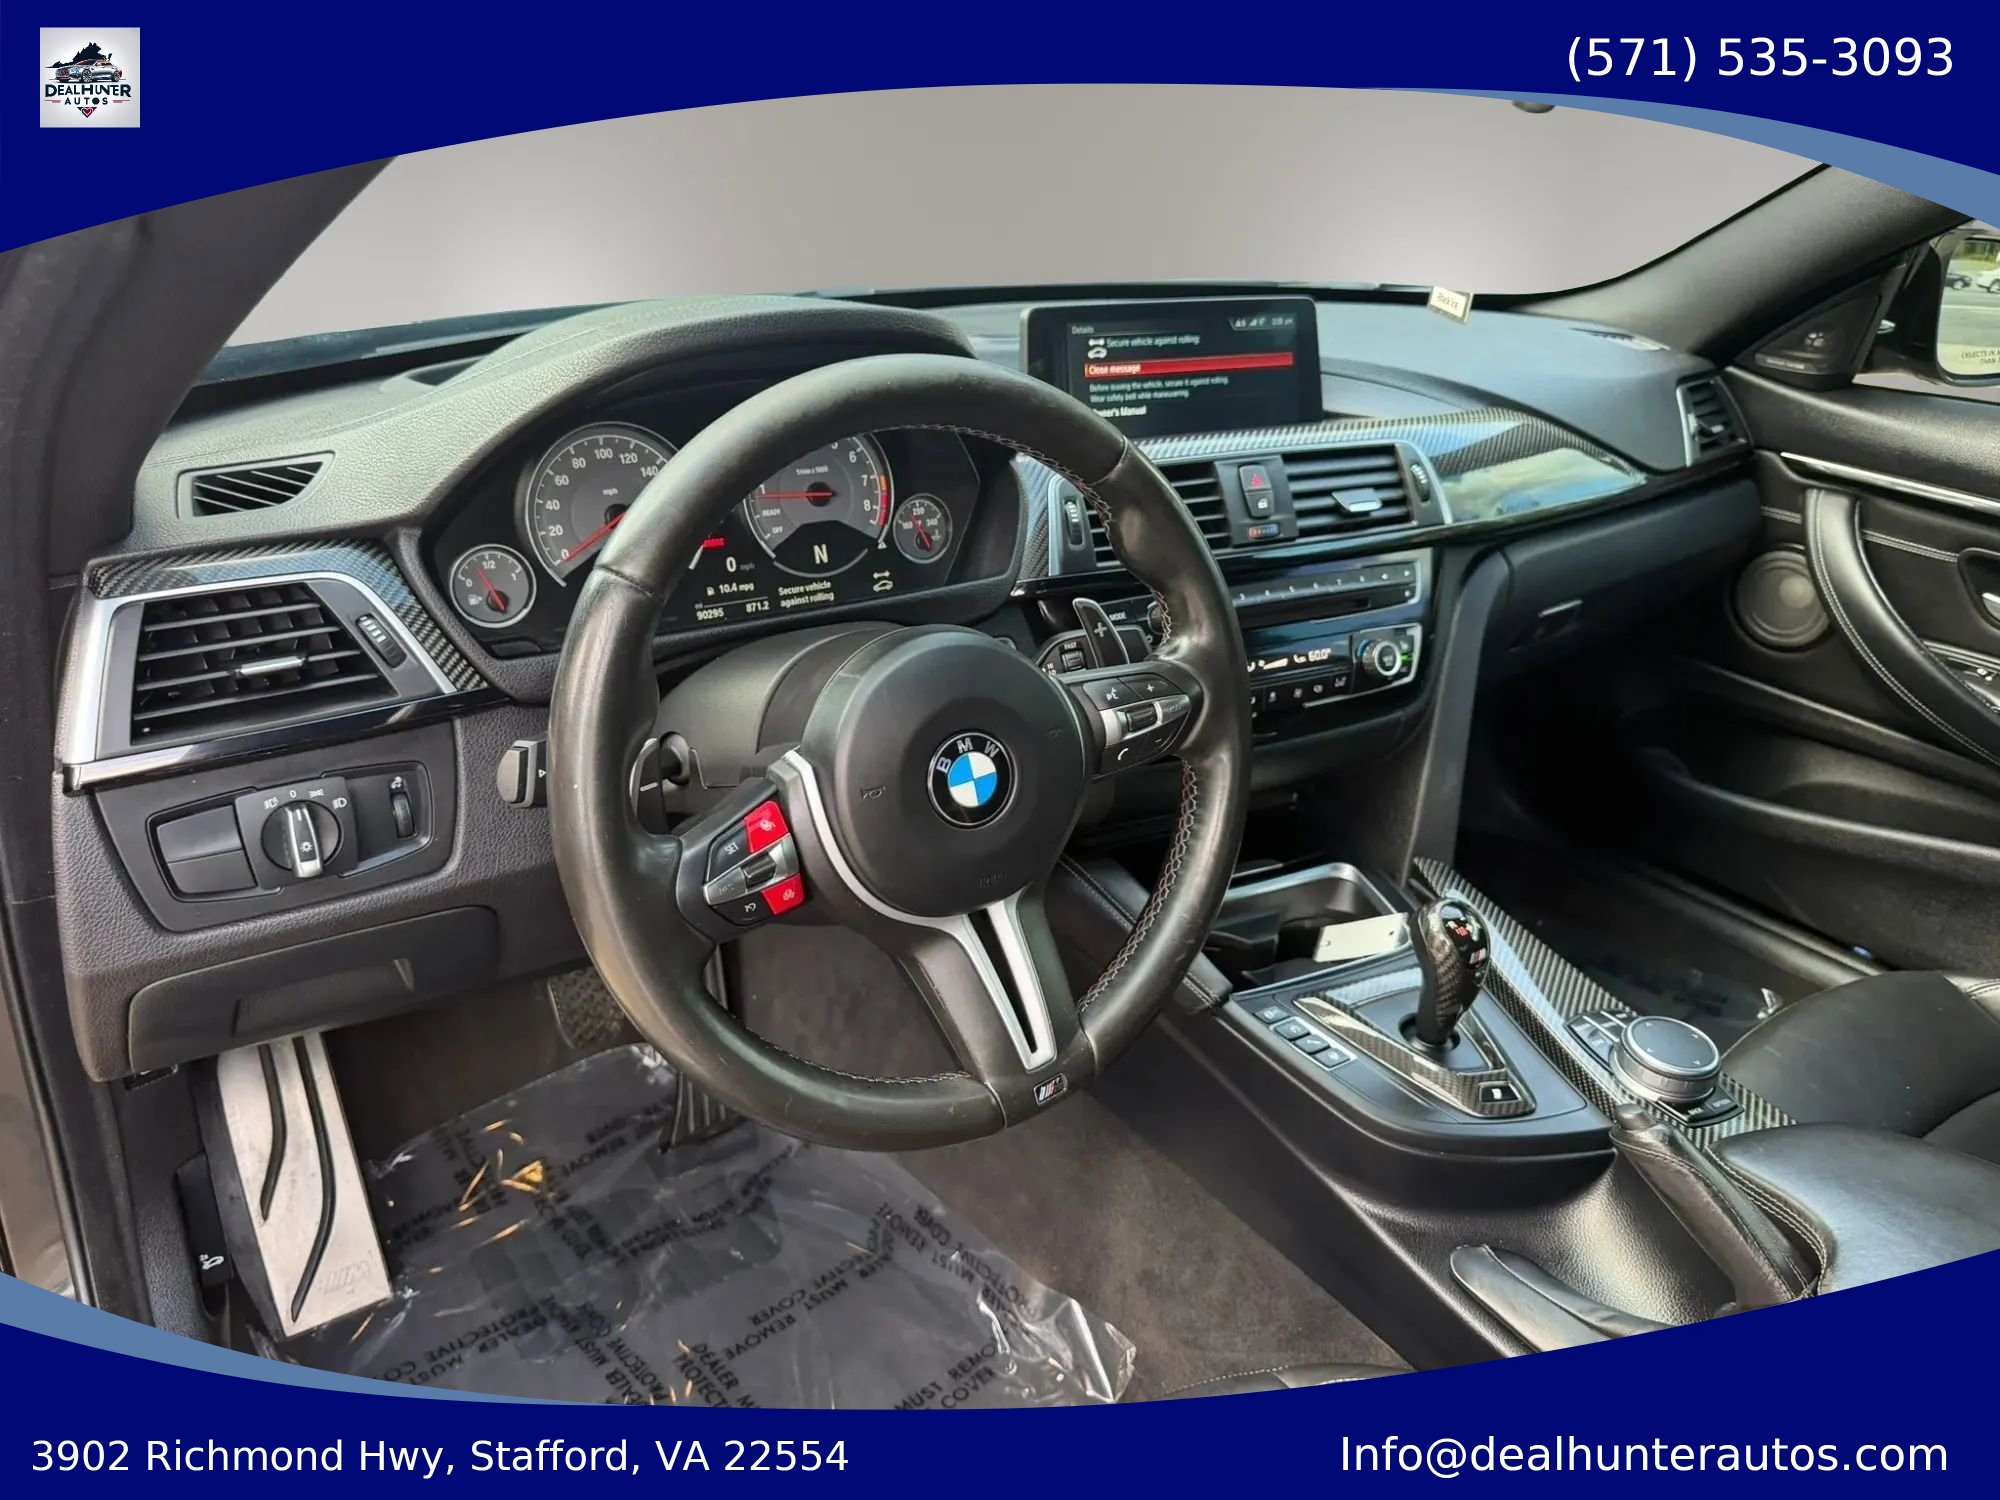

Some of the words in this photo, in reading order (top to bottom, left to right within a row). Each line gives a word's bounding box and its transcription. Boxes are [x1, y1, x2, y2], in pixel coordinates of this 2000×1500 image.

[1107, 338, 1129, 347] Secure
[1131, 336, 1153, 346] vehicle
[1120, 406, 1147, 416] Manual
[594, 448, 613, 459] 100
[620, 453, 638, 464] 120
[849, 451, 857, 463] 6
[572, 458, 586, 469] 80
[640, 466, 658, 477] 140
[555, 475, 569, 486] 60
[861, 475, 868, 487] 7
[602, 488, 618, 496] mph
[759, 484, 766, 494] 1
[545, 500, 560, 510] 40
[863, 500, 871, 511] 8
[762, 509, 781, 517] READY
[549, 525, 563, 536] 20
[772, 526, 783, 534] OFF
[561, 549, 569, 559] 0
[813, 544, 829, 565] N
[482, 560, 496, 569] 1/2
[726, 556, 737, 572] 0
[739, 563, 755, 571] mph
[511, 573, 517, 581] 1
[465, 579, 473, 587] 0
[718, 582, 738, 594] 10.4
[739, 582, 754, 592] mpg
[778, 586, 804, 596] Secure
[805, 581, 832, 592] vehicle
[780, 595, 809, 608] against
[810, 592, 835, 603] rolling
[696, 608, 725, 620] 90295
[746, 601, 770, 613] 871.2
[1109, 611, 1127, 620] MODE
[1064, 642, 1077, 650] FAST
[936, 737, 1000, 774] BMW
[724, 842, 739, 855] SET
[804, 1279, 848, 1310] MUST
[752, 1289, 806, 1326] COVER
[478, 1314, 547, 1353] DEALER
[725, 1314, 796, 1360] REMOVE
[410, 1354, 464, 1385] MUST
[692, 1343, 739, 1390] DEALER
[894, 1381, 942, 1410] MUST
[947, 1343, 996, 1381] REMO
[941, 1366, 995, 1409] COVER
